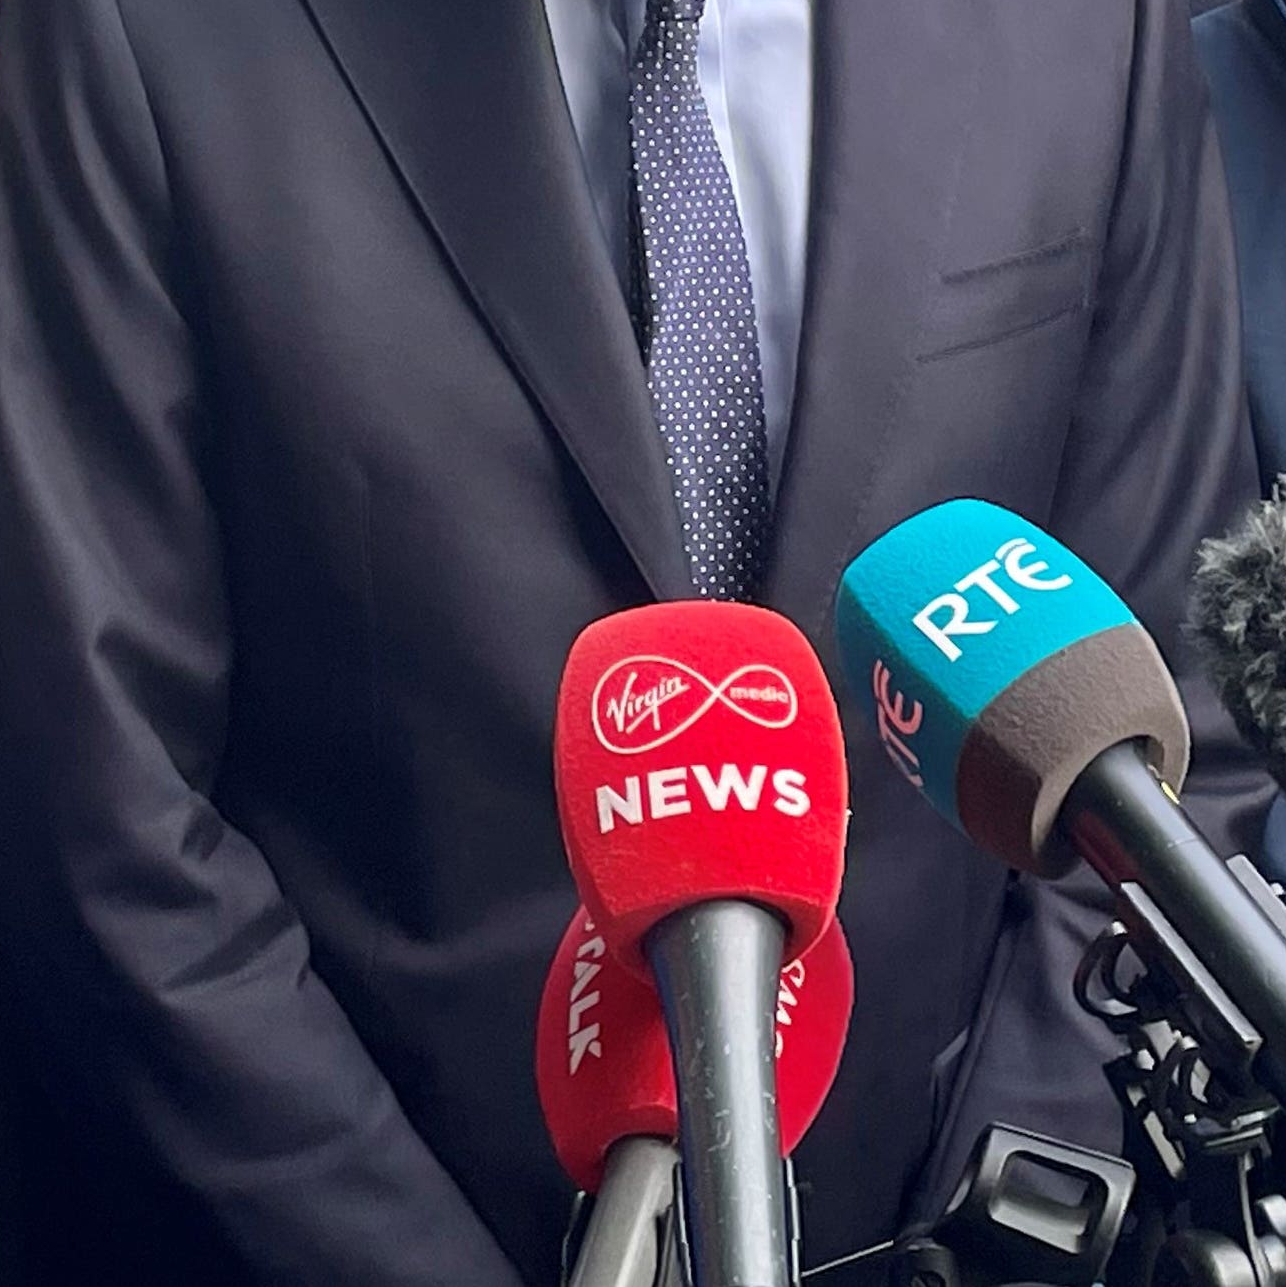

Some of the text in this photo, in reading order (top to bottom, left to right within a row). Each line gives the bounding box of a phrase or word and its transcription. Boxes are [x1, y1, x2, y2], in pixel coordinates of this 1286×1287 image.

[606, 671, 790, 735] Virgin media
[595, 762, 811, 834] NEWS
